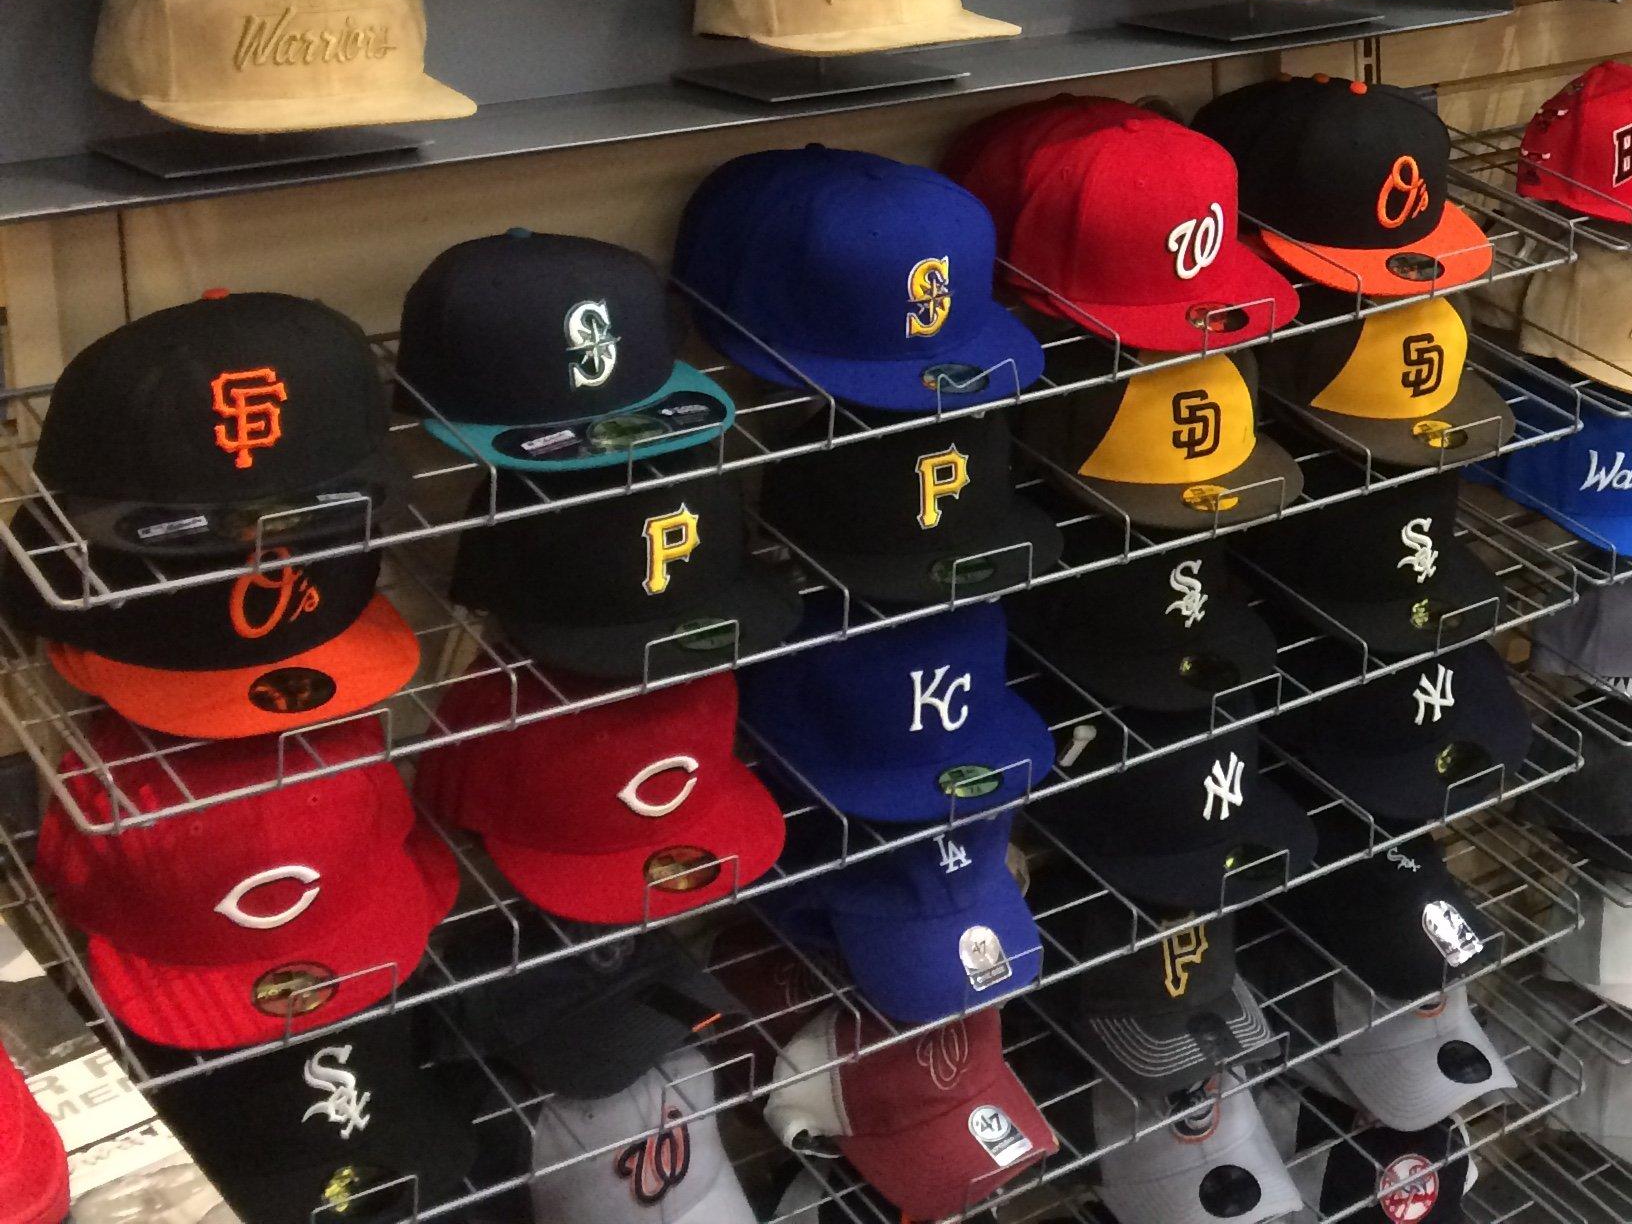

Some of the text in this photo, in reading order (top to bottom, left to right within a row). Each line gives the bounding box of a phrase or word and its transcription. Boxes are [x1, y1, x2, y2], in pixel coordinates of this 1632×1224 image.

[233, 5, 397, 73] Warriors
[1167, 202, 1225, 279] W
[904, 255, 954, 338] S
[564, 300, 621, 389] S
[1401, 332, 1444, 397] SD
[210, 367, 288, 468] SF
[1172, 390, 1220, 459] SD
[914, 442, 970, 529] P
[643, 503, 700, 596] P
[909, 665, 972, 731] KC
[1414, 663, 1454, 726] NY
[616, 755, 698, 817] C
[1202, 752, 1244, 820] NY
[933, 833, 972, 874] LA
[213, 864, 321, 929] C
